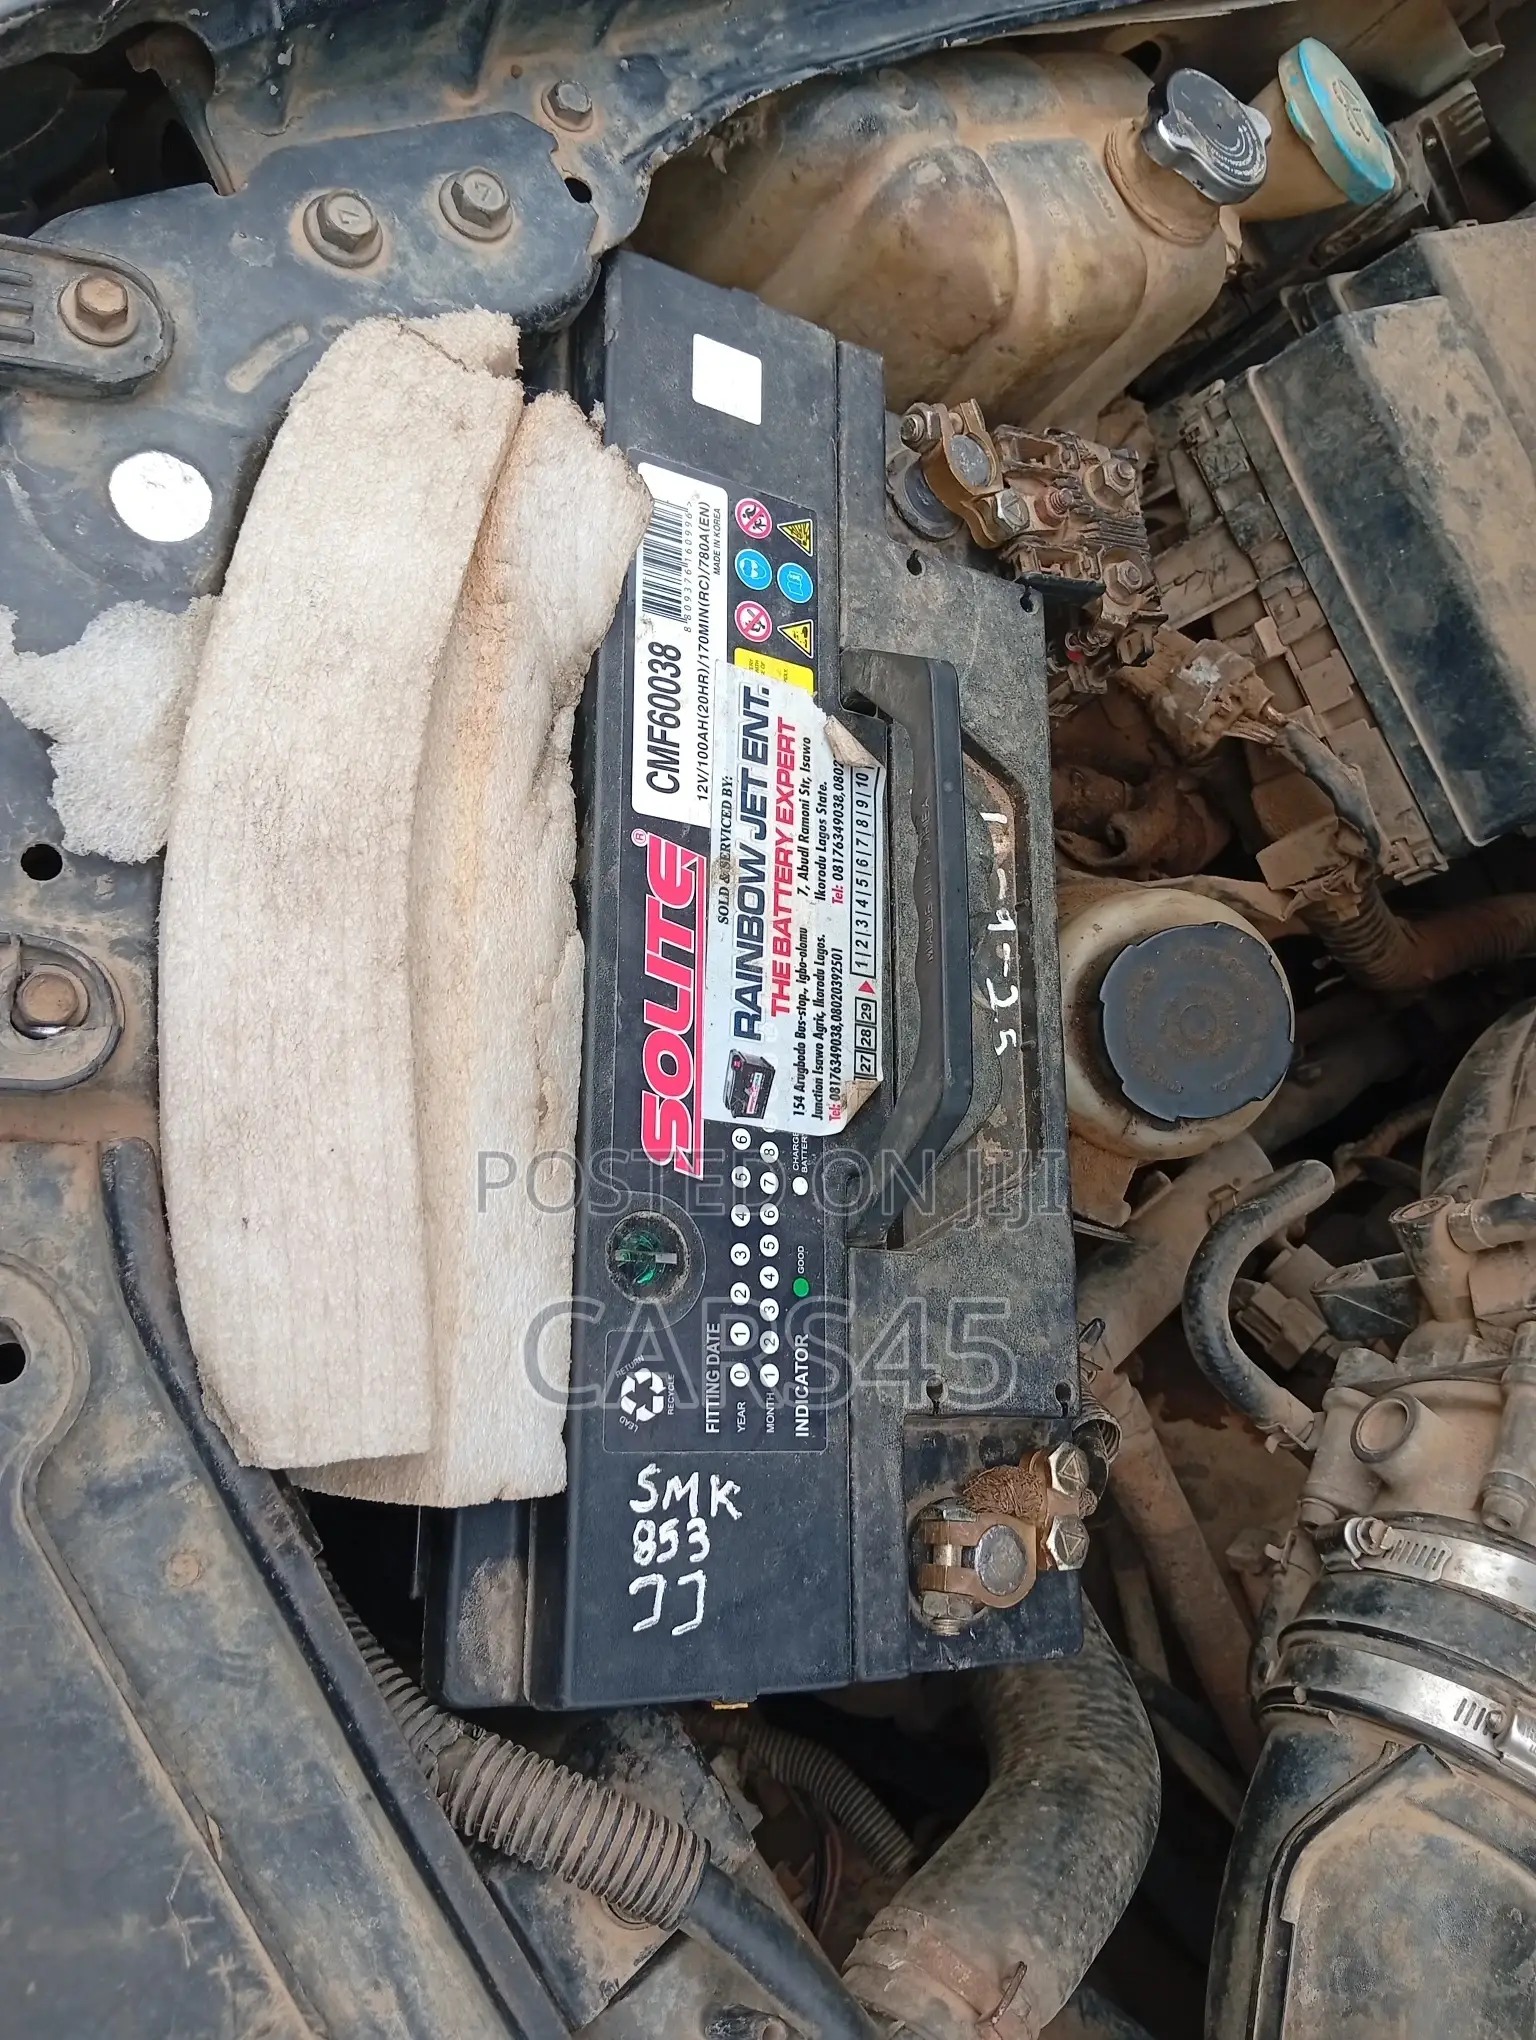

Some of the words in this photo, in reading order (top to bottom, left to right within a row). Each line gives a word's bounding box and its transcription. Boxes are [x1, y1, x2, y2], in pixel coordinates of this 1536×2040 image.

[713, 508, 721, 538] KOREA
[713, 539, 721, 549] IN
[713, 550, 721, 576] MADE
[697, 501, 712, 801] 12V/100AH(20HR)/170MIN(RC)/780A(EN)
[645, 641, 681, 795] CMF60038
[742, 684, 770, 766] ENT.
[800, 737, 812, 773] Isawo
[775, 716, 796, 826] EXPERT
[855, 772, 869, 788] 10
[721, 776, 733, 798] BY:
[799, 777, 812, 797] Str,
[815, 781, 828, 816] State.
[740, 766, 768, 841] JET
[855, 800, 869, 809] 9
[798, 798, 811, 844] Ramoni
[855, 819, 869, 829] 8
[719, 800, 732, 869] SERVICED
[815, 819, 830, 853] Lagos
[855, 839, 869, 848] 7
[855, 859, 869, 868] 6
[719, 870, 731, 884] &
[814, 856, 827, 902] Ikorodu
[855, 878, 869, 888] 5
[772, 826, 793, 957] BATTERY
[797, 884, 810, 898] 7,
[831, 884, 844, 905] Tel:
[718, 885, 731, 925] SOLD
[855, 899, 869, 909] 4
[855, 919, 869, 928] 3
[733, 841, 766, 1041] RAINBOW
[813, 933, 827, 967] Lagos.
[855, 939, 869, 949] 2
[770, 960, 791, 1018] THE
[813, 968, 825, 1008] Ikorodu
[641, 831, 703, 1176] SOLITE
[861, 1002, 872, 1021] 29
[813, 1010, 828, 1041] Agric,
[829, 947, 845, 1102] 08176349038,08020392501
[861, 1028, 872, 1048] 28
[793, 1042, 809, 1094] Arugbodo
[813, 1043, 825, 1076] Isawo
[861, 1054, 872, 1073] 27
[793, 1096, 806, 1117] 154
[811, 1079, 824, 1121] Junction
[828, 1103, 841, 1122] Tel:
[735, 1135, 748, 1144] 6
[764, 1148, 775, 1157] 8
[735, 1172, 747, 1182] 5
[764, 1178, 775, 1187] 7
[734, 1212, 747, 1221] 4
[764, 1210, 775, 1219] 6
[734, 1250, 747, 1260] 3
[764, 1241, 775, 1251] 5
[797, 1245, 805, 1274] GOOD
[764, 1273, 775, 1282] 4
[734, 1289, 747, 1298] 2
[764, 1305, 775, 1314] 3
[706, 1322, 721, 1366] DATE
[764, 1337, 775, 1347] 2
[614, 1354, 645, 1379] RETURN
[734, 1370, 747, 1380] 0
[667, 1373, 675, 1416] RECYCLE
[794, 1333, 810, 1437] INDICATOR
[705, 1369, 721, 1434] FITTING
[766, 1392, 775, 1433] MONTH
[619, 1416, 639, 1433] LEAD
[737, 1401, 746, 1433] YEAR
[629, 1462, 743, 1521] SMK
[632, 1517, 711, 1566] 853
